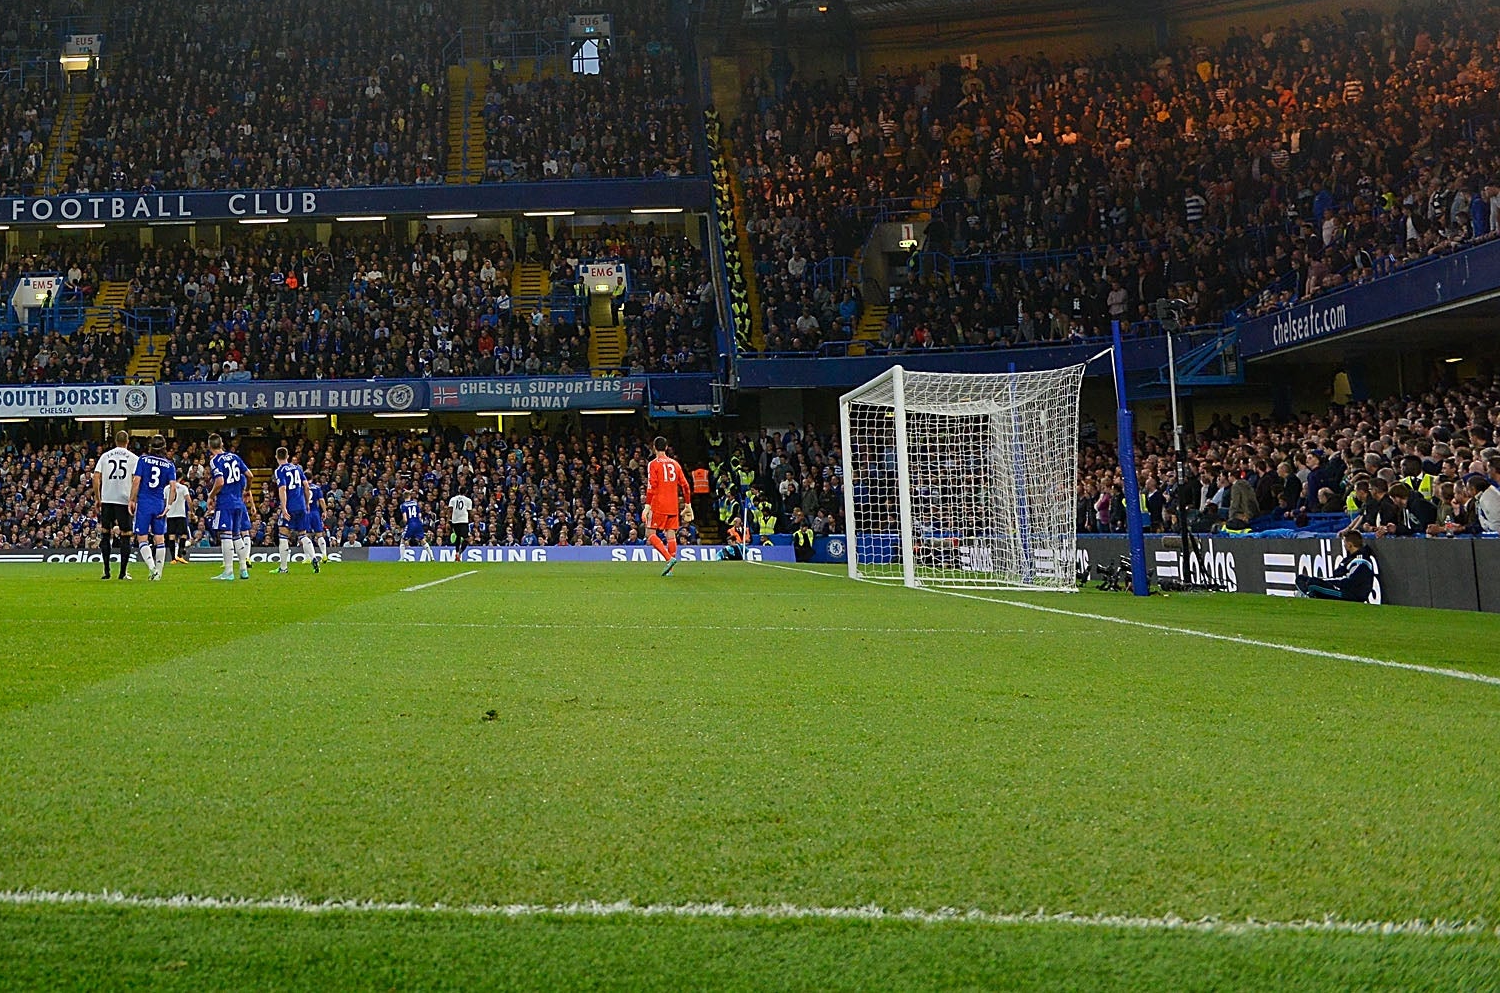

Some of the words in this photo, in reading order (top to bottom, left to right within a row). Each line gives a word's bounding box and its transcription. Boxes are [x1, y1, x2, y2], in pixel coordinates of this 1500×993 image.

[75, 37, 86, 46] EU
[12, 195, 192, 221] FOOTBALL
[228, 192, 317, 215] CLUB
[591, 268, 605, 277] EM
[606, 267, 613, 277] 6
[32, 280, 46, 289] EM
[47, 280, 53, 289] 5
[1273, 303, 1347, 347] chelseafc.com
[459, 382, 522, 395] CHELSEA
[529, 379, 621, 394] SUPPORTERS
[55, 388, 119, 406] DORSET
[171, 391, 249, 410] BRISTOL
[256, 393, 268, 408] &
[274, 389, 321, 408] BATH
[329, 388, 383, 407] BLUES
[511, 395, 570, 409] NORWAY
[39, 407, 73, 415] CHELSEA
[108, 459, 128, 480] 25
[148, 466, 161, 488] 3
[223, 460, 241, 484] 26
[663, 463, 676, 483] 13
[285, 469, 302, 490] 24
[407, 506, 417, 518] 14
[455, 499, 464, 510] 10
